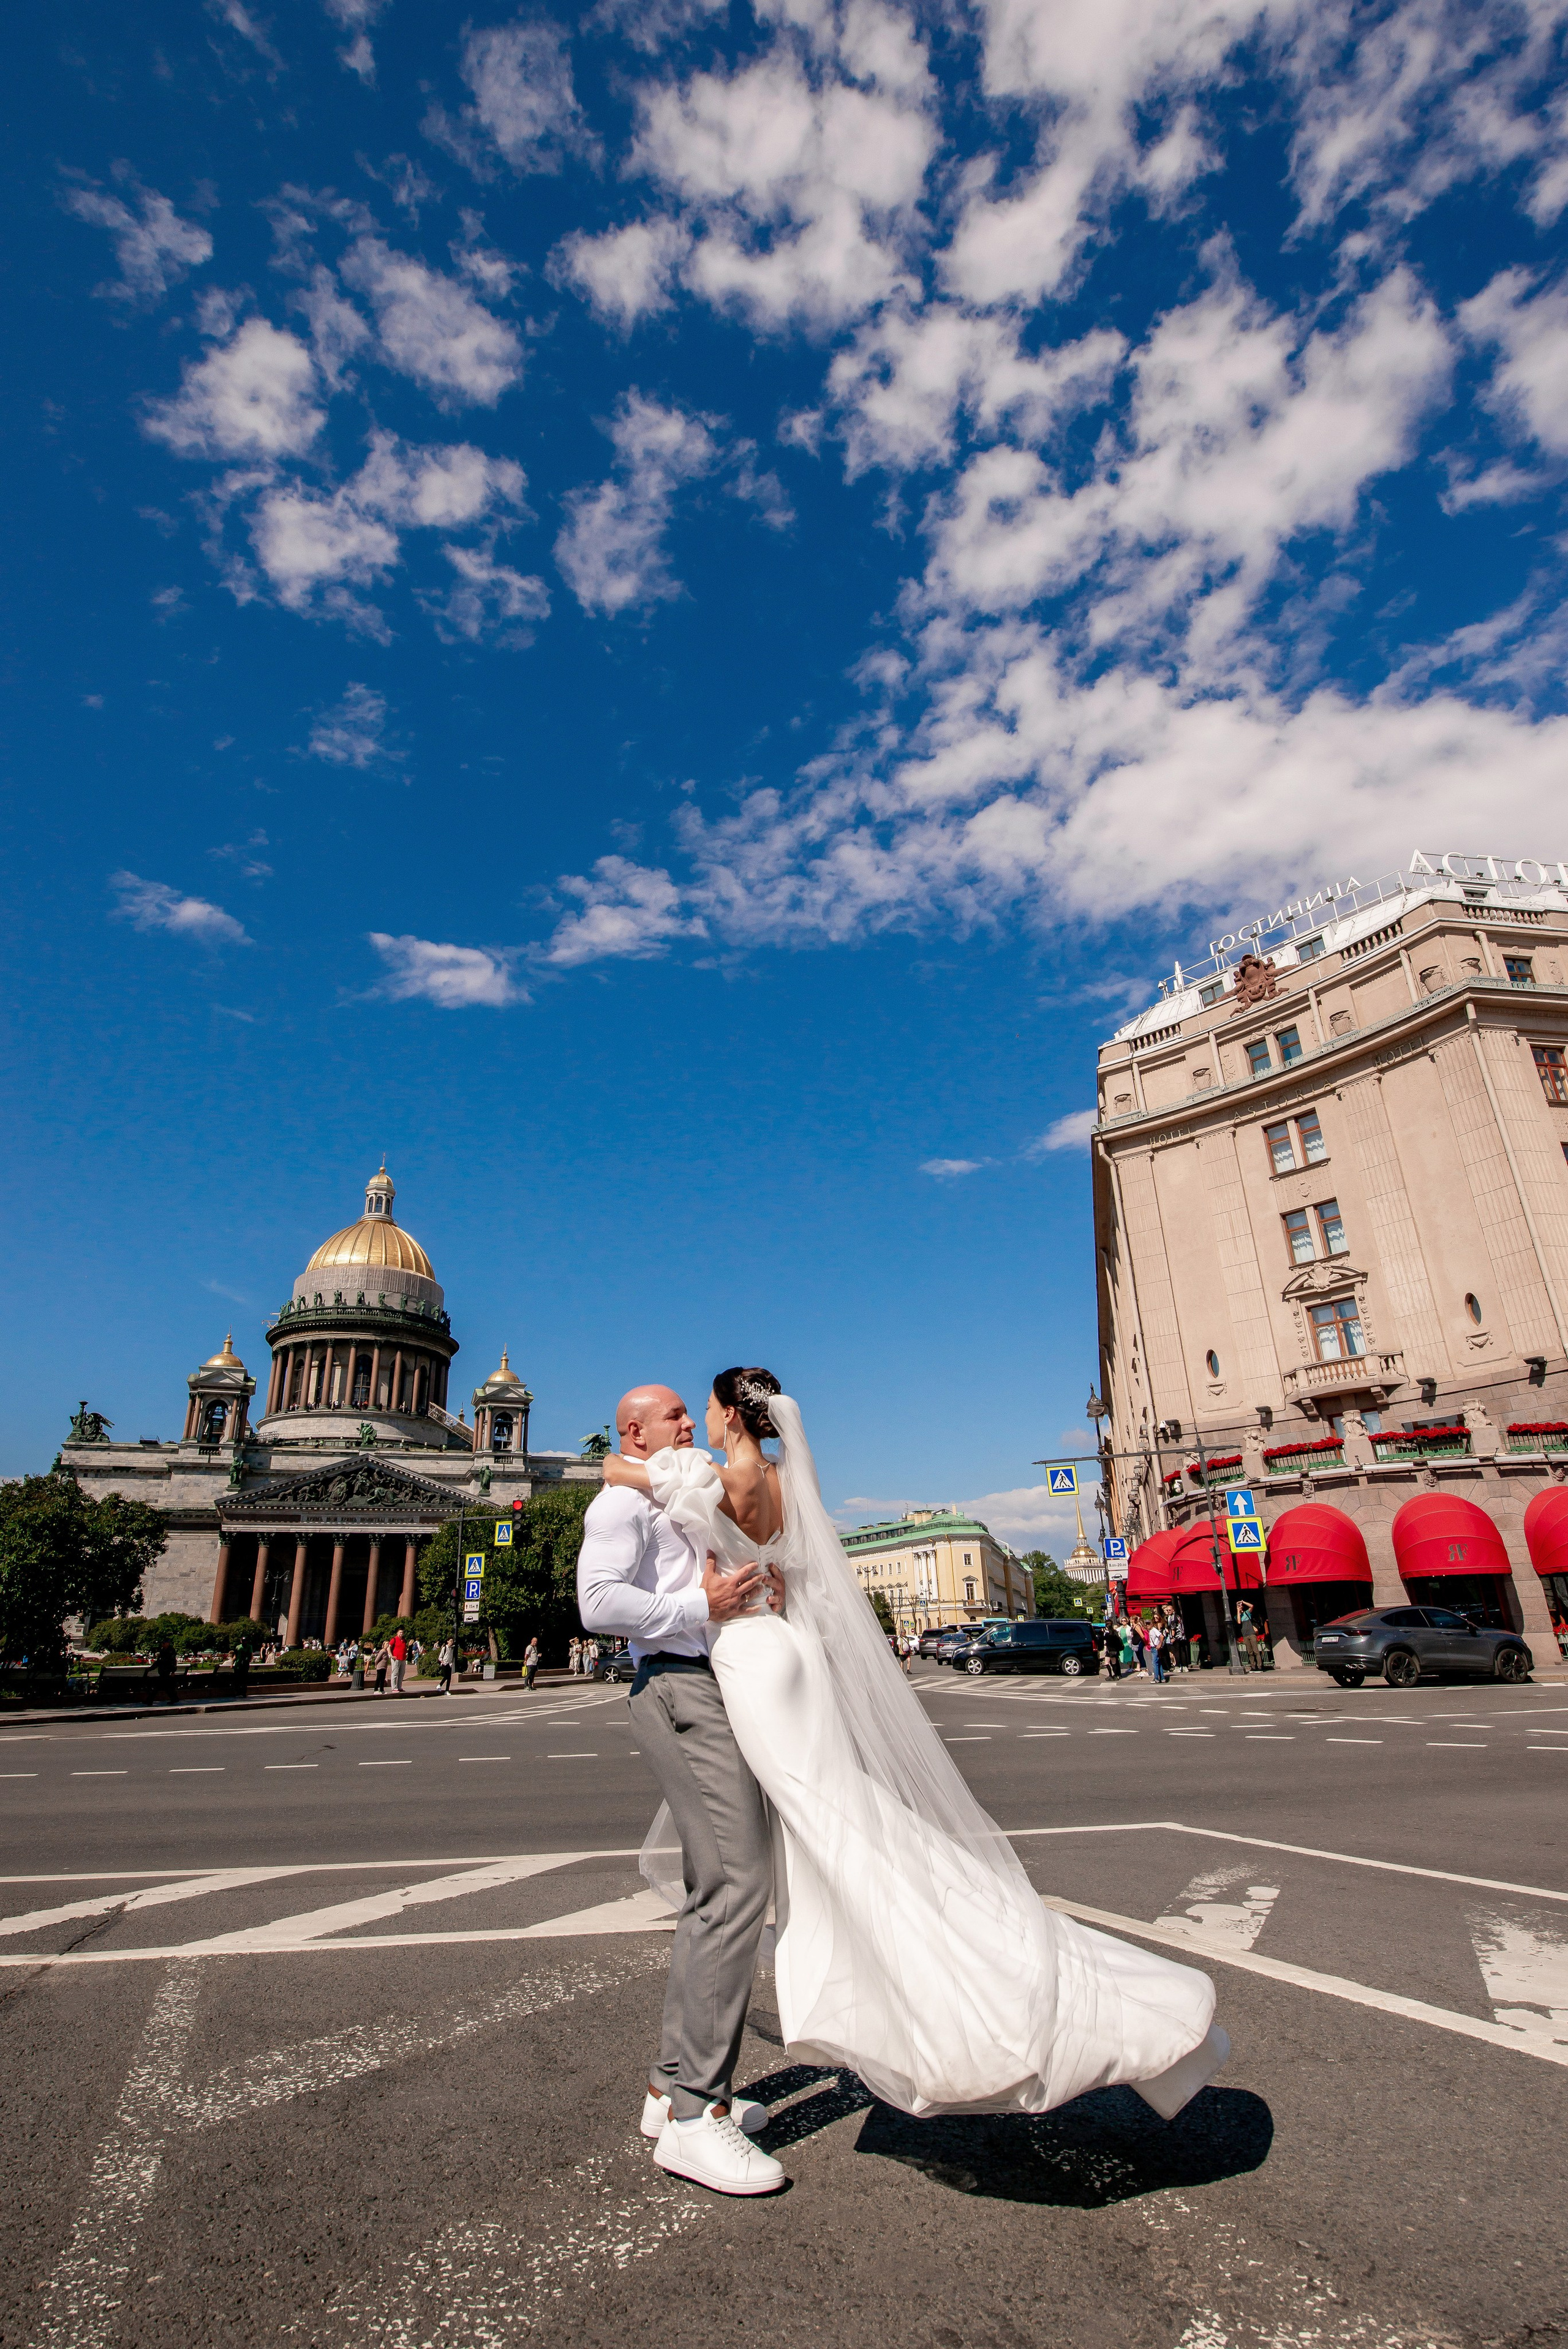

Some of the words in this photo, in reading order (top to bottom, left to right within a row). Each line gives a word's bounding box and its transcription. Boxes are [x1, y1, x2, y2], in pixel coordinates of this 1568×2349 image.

[1209, 876, 1362, 957] ГОСТИНИЦА
[1150, 1127, 1194, 1148] HOTEL
[1233, 1078, 1333, 1123] ASTORIA
[1375, 1037, 1427, 1069] HOTEL
